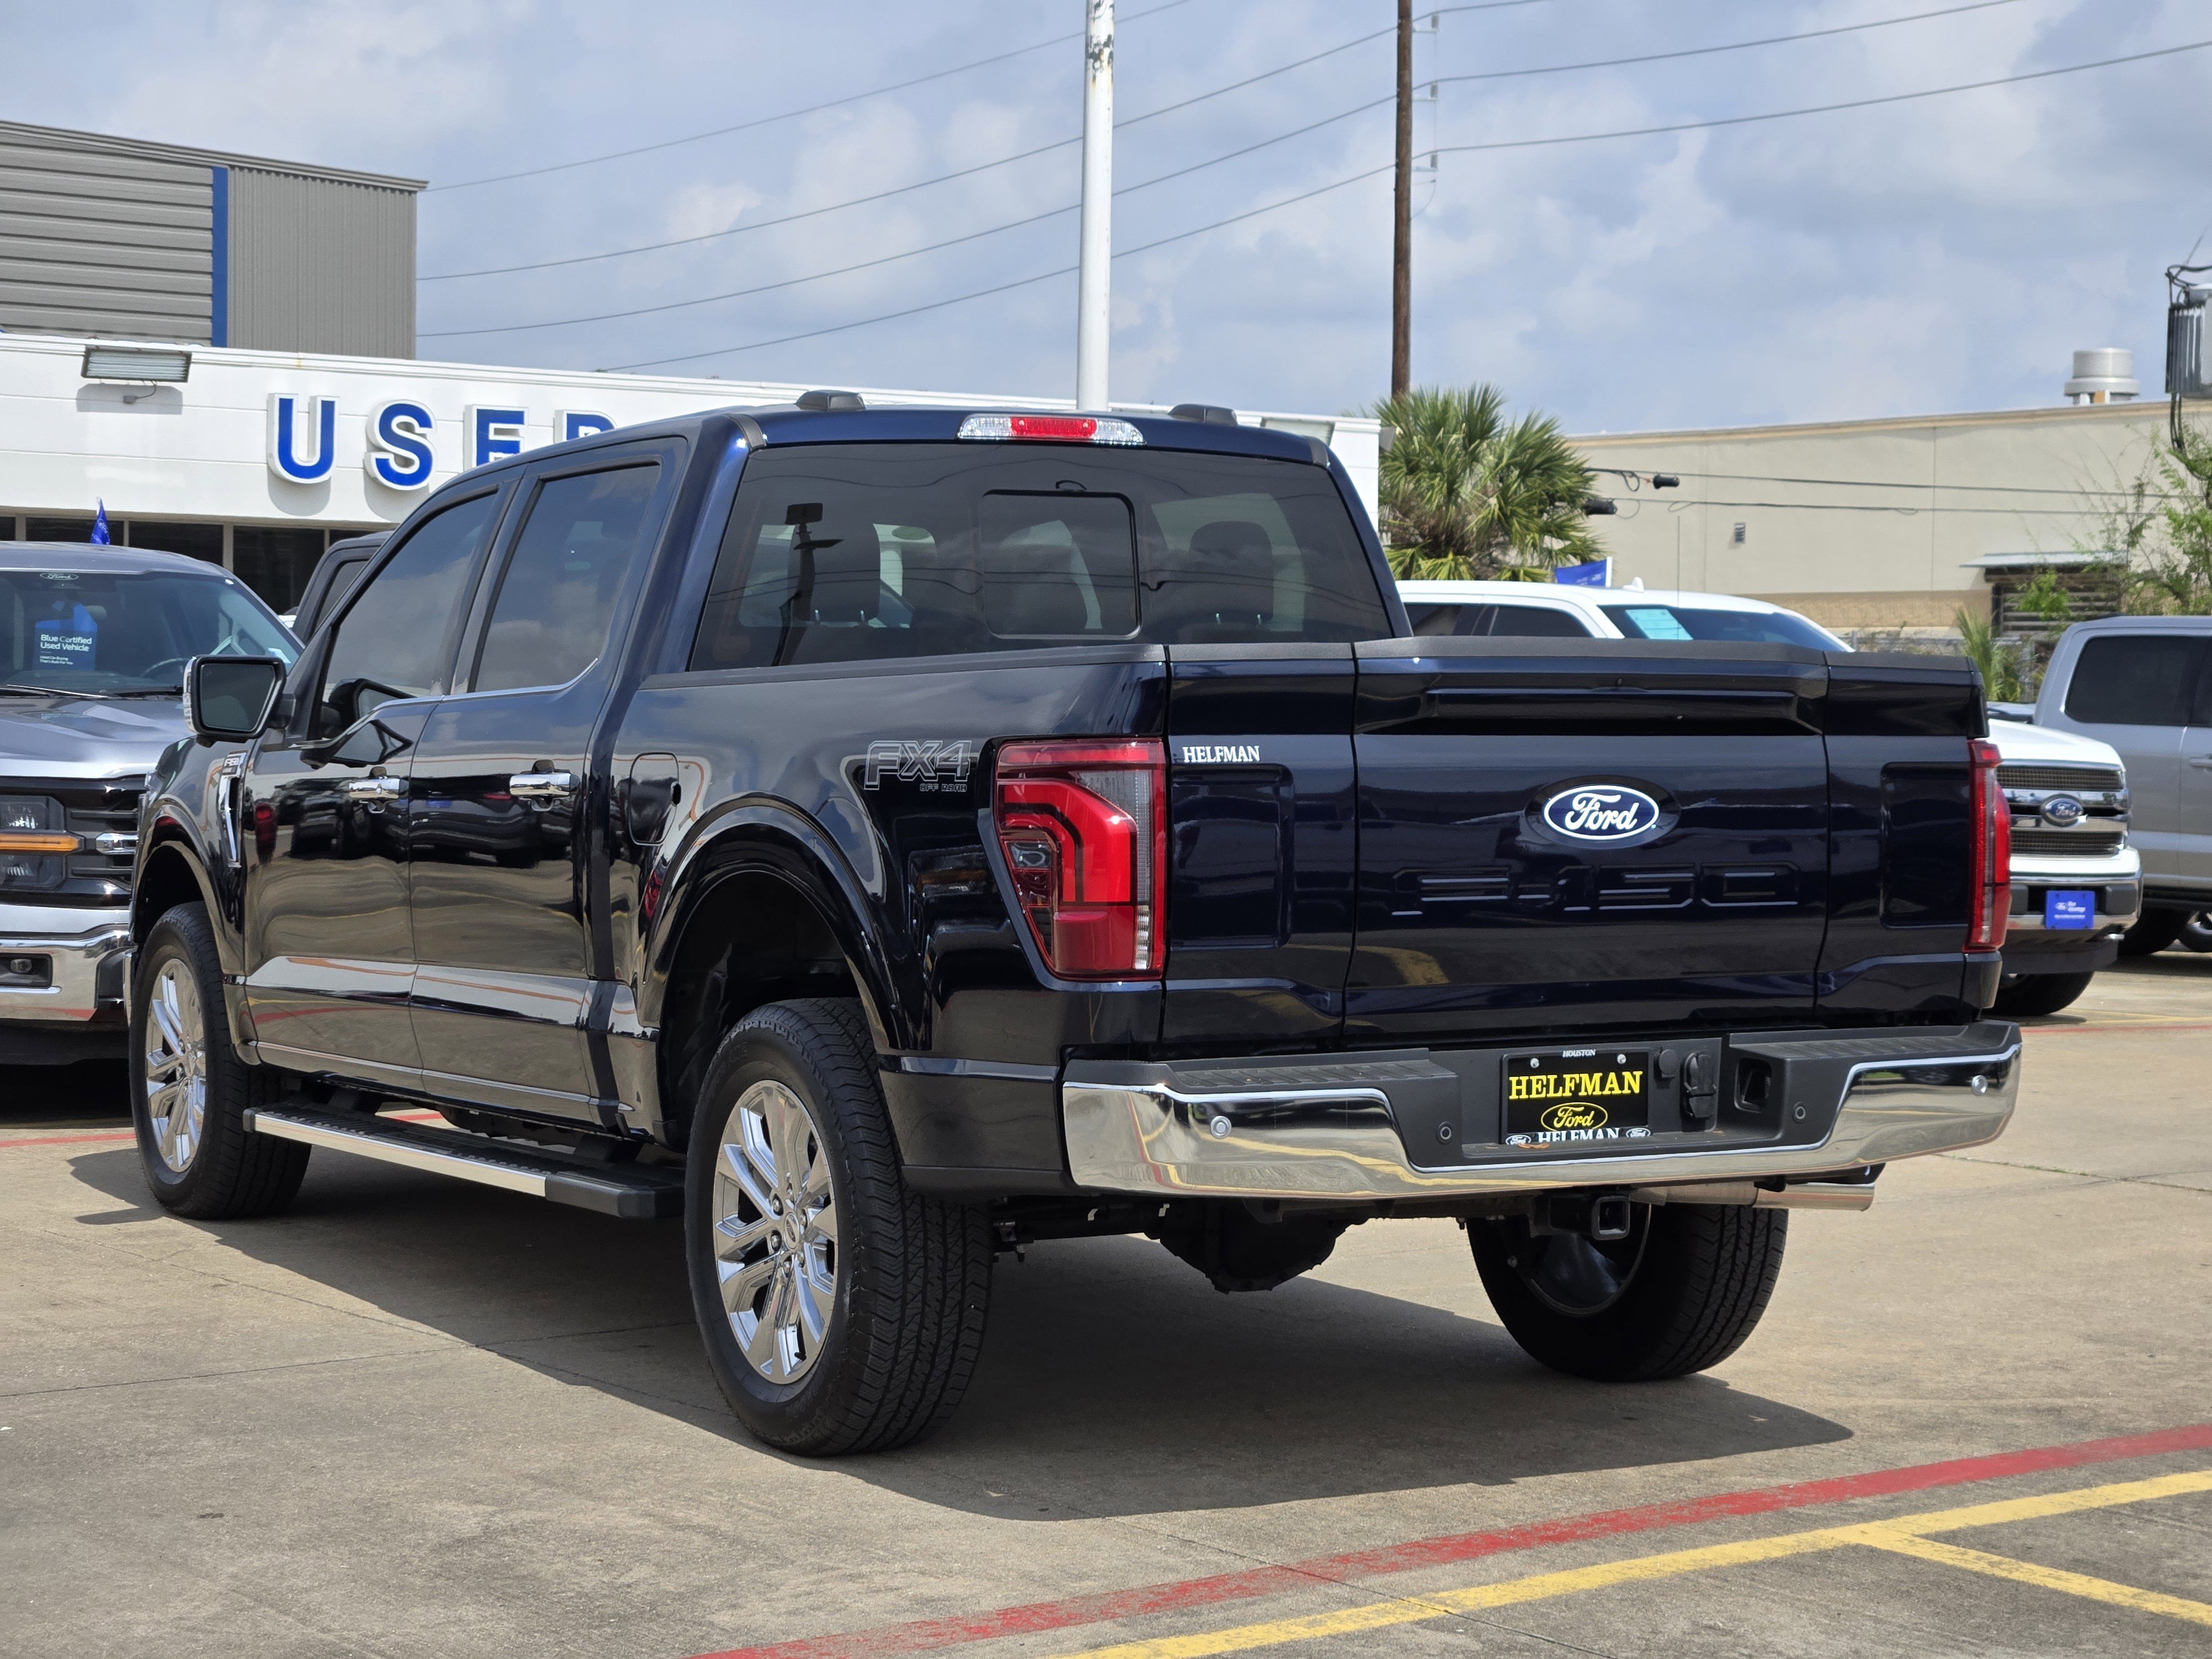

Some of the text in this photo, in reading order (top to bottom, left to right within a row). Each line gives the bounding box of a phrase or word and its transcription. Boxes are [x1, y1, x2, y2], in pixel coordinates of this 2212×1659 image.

[59, 636, 92, 644] Certified
[62, 643, 89, 651] Vehicle
[1182, 745, 1260, 763] HELFMAN
[864, 740, 972, 791] FX4
[920, 783, 967, 792] OFF ROAD
[1564, 792, 1640, 830] Ford
[1562, 1049, 1596, 1057] HOUSTON
[1509, 1071, 1643, 1099] HELFMAN
[1553, 1107, 1595, 1128] Ford
